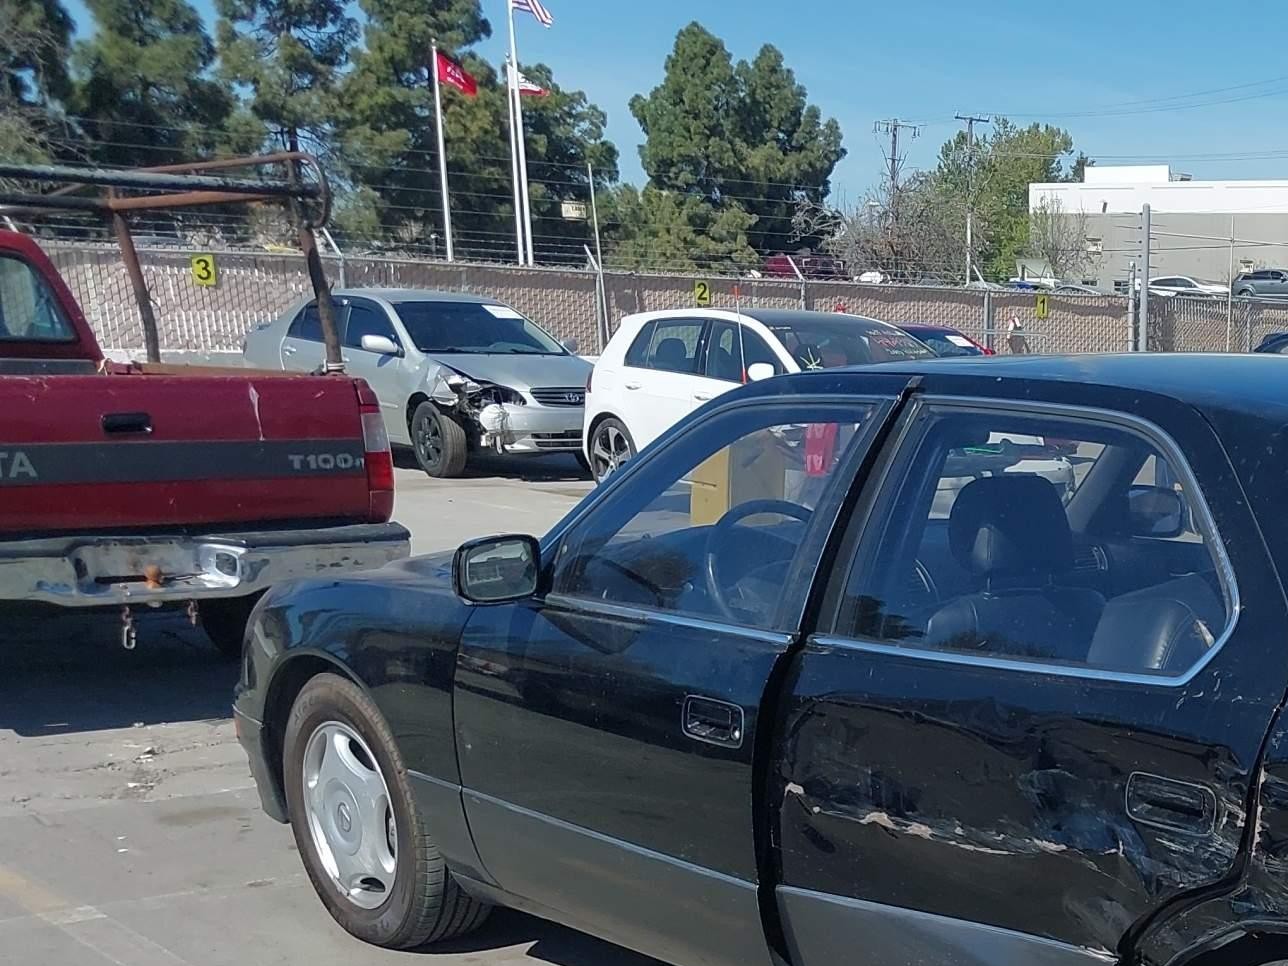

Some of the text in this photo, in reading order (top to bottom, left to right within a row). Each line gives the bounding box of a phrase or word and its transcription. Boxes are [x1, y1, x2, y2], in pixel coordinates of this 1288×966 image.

[196, 258, 212, 281] 3
[697, 282, 708, 301] 2
[1039, 297, 1046, 314] 1
